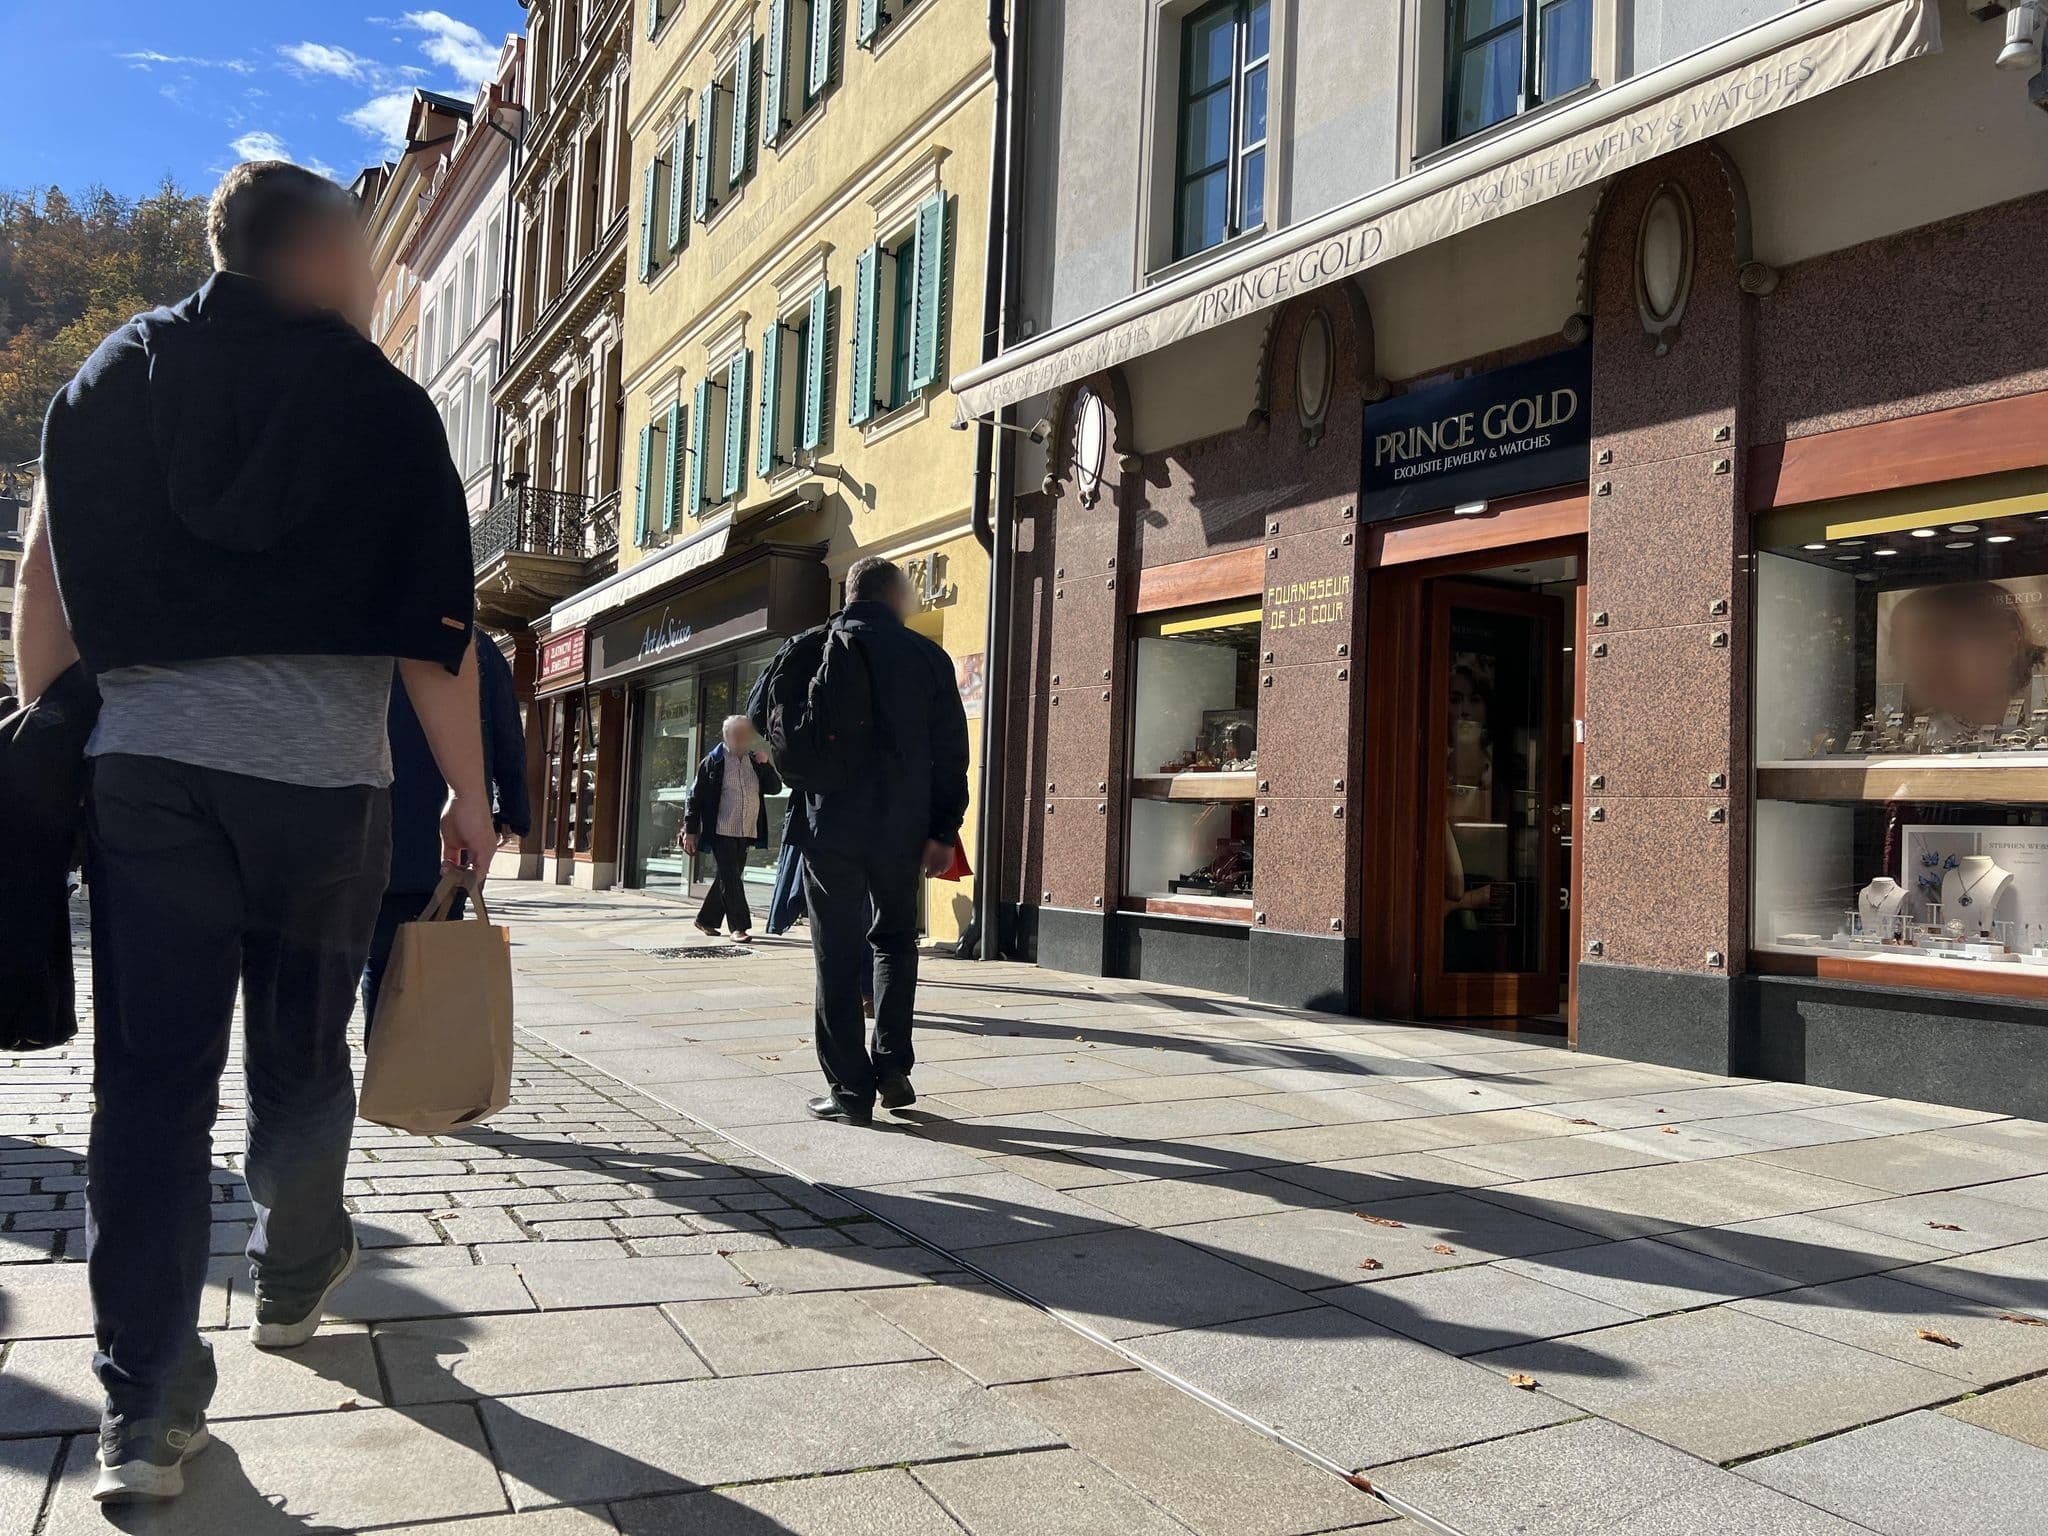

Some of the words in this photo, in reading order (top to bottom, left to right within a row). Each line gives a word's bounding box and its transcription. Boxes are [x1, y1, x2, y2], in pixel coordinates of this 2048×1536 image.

[1460, 159, 1560, 215] EXQUISITE
[1564, 118, 1660, 177] JEWELRY
[1666, 114, 1683, 133] &
[1691, 56, 1817, 122] WATCHES
[1201, 261, 1291, 324] PRINCE
[1298, 226, 1383, 284] GOLD
[1375, 411, 1475, 467] PRINCE
[1482, 388, 1578, 440] GOLD
[1394, 458, 1443, 480] EXQUISITE
[1443, 448, 1488, 472] JEWELRY
[1489, 447, 1497, 458] &
[1499, 433, 1551, 456] WATCHES
[1267, 575, 1350, 606] FOURNISSEUR
[1270, 610, 1286, 630] DE
[1289, 606, 1306, 627] LA
[1311, 601, 1344, 624] COUR
[638, 625, 656, 662] Art
